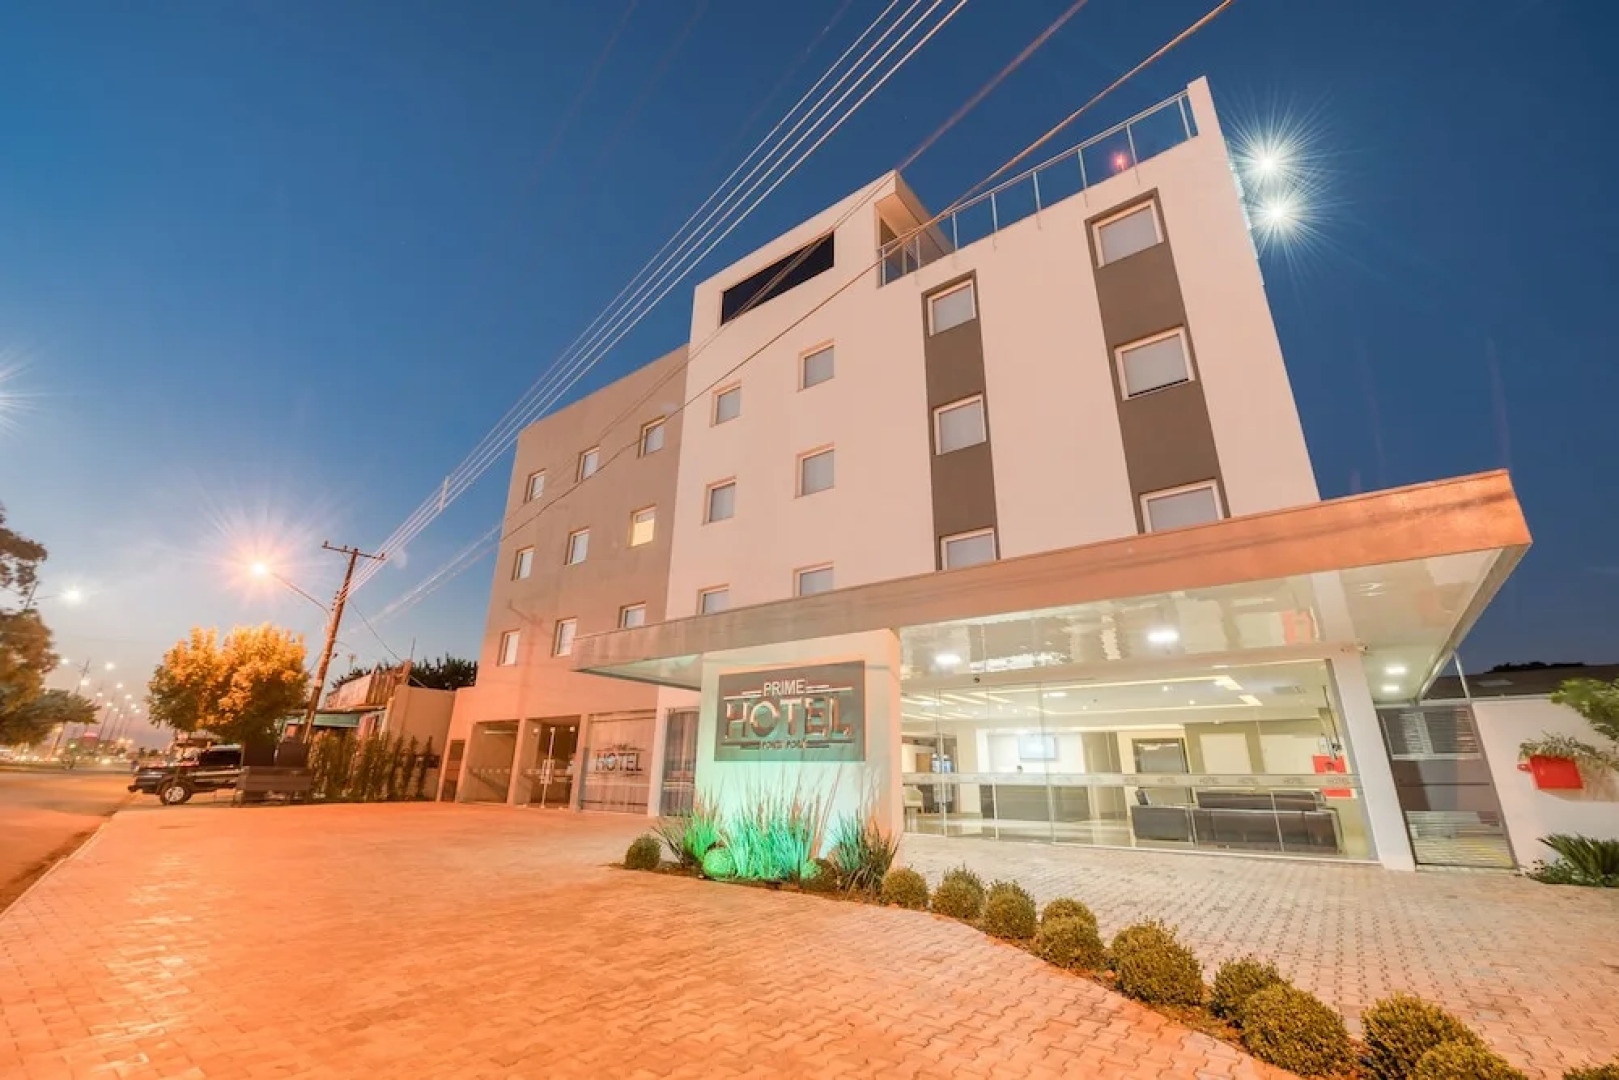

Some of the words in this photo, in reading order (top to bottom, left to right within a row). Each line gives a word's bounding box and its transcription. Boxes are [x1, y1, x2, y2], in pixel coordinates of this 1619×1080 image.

[763, 679, 806, 697] PRIME
[725, 697, 853, 739] HOTEL
[595, 752, 644, 772] HOTEL
